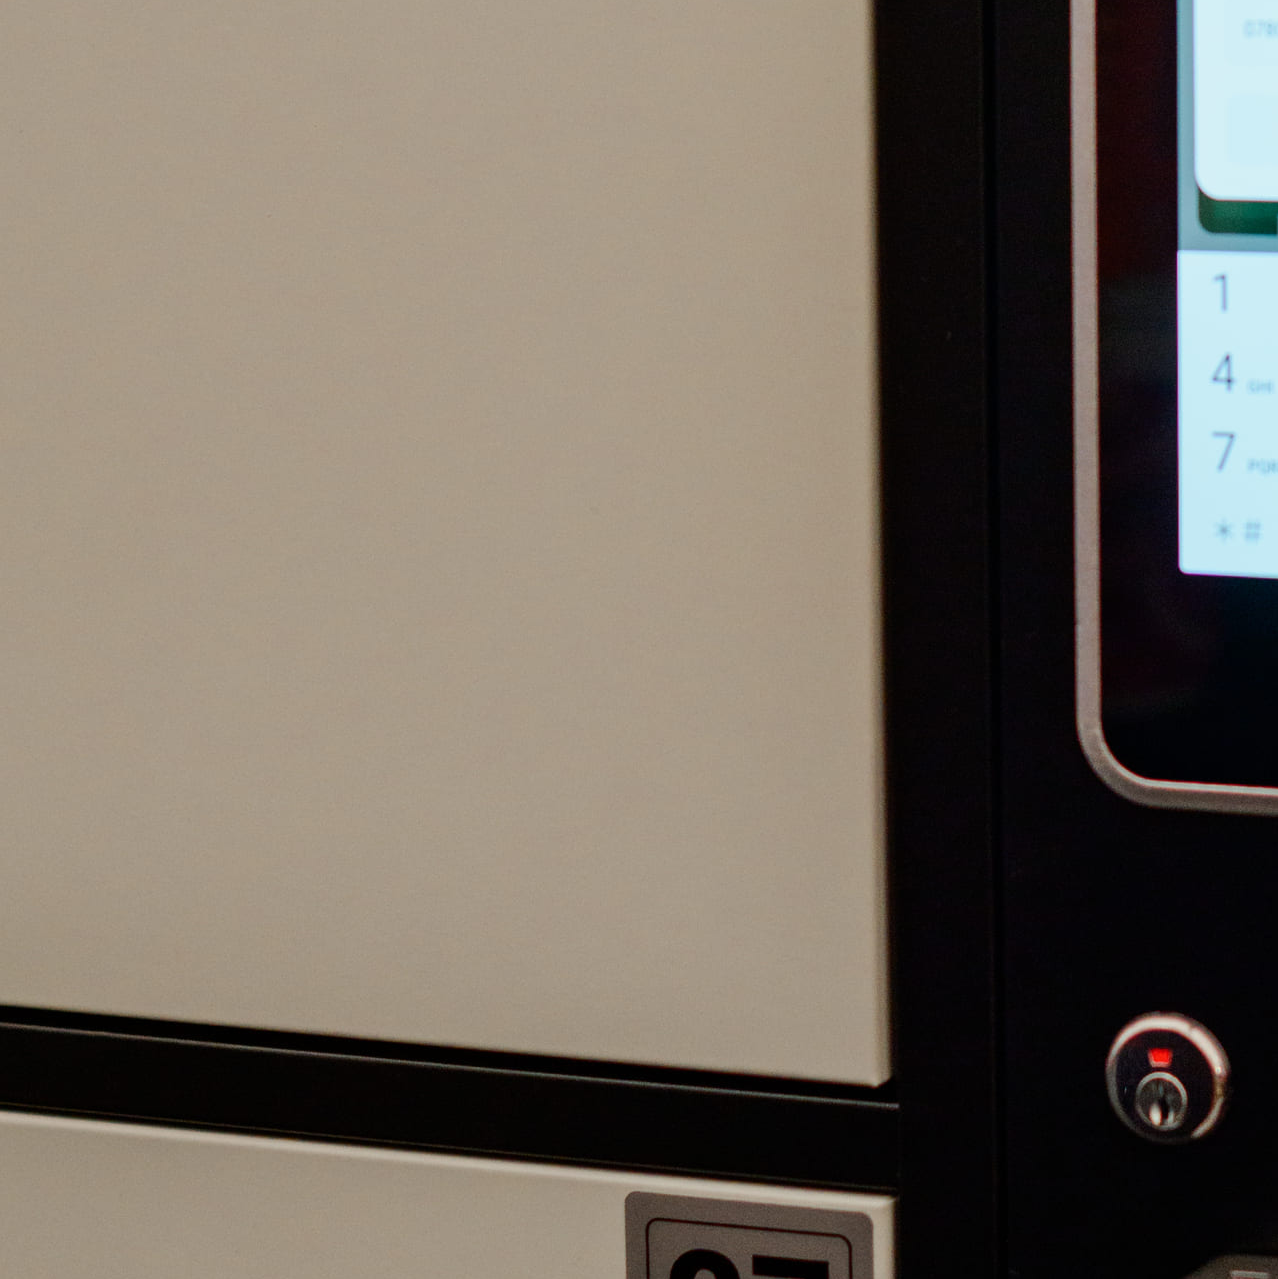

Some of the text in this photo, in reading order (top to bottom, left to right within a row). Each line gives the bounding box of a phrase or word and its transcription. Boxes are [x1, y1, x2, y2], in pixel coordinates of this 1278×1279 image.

[1213, 273, 1229, 312] 1
[1211, 353, 1236, 393] 4
[1212, 432, 1236, 472] 7
